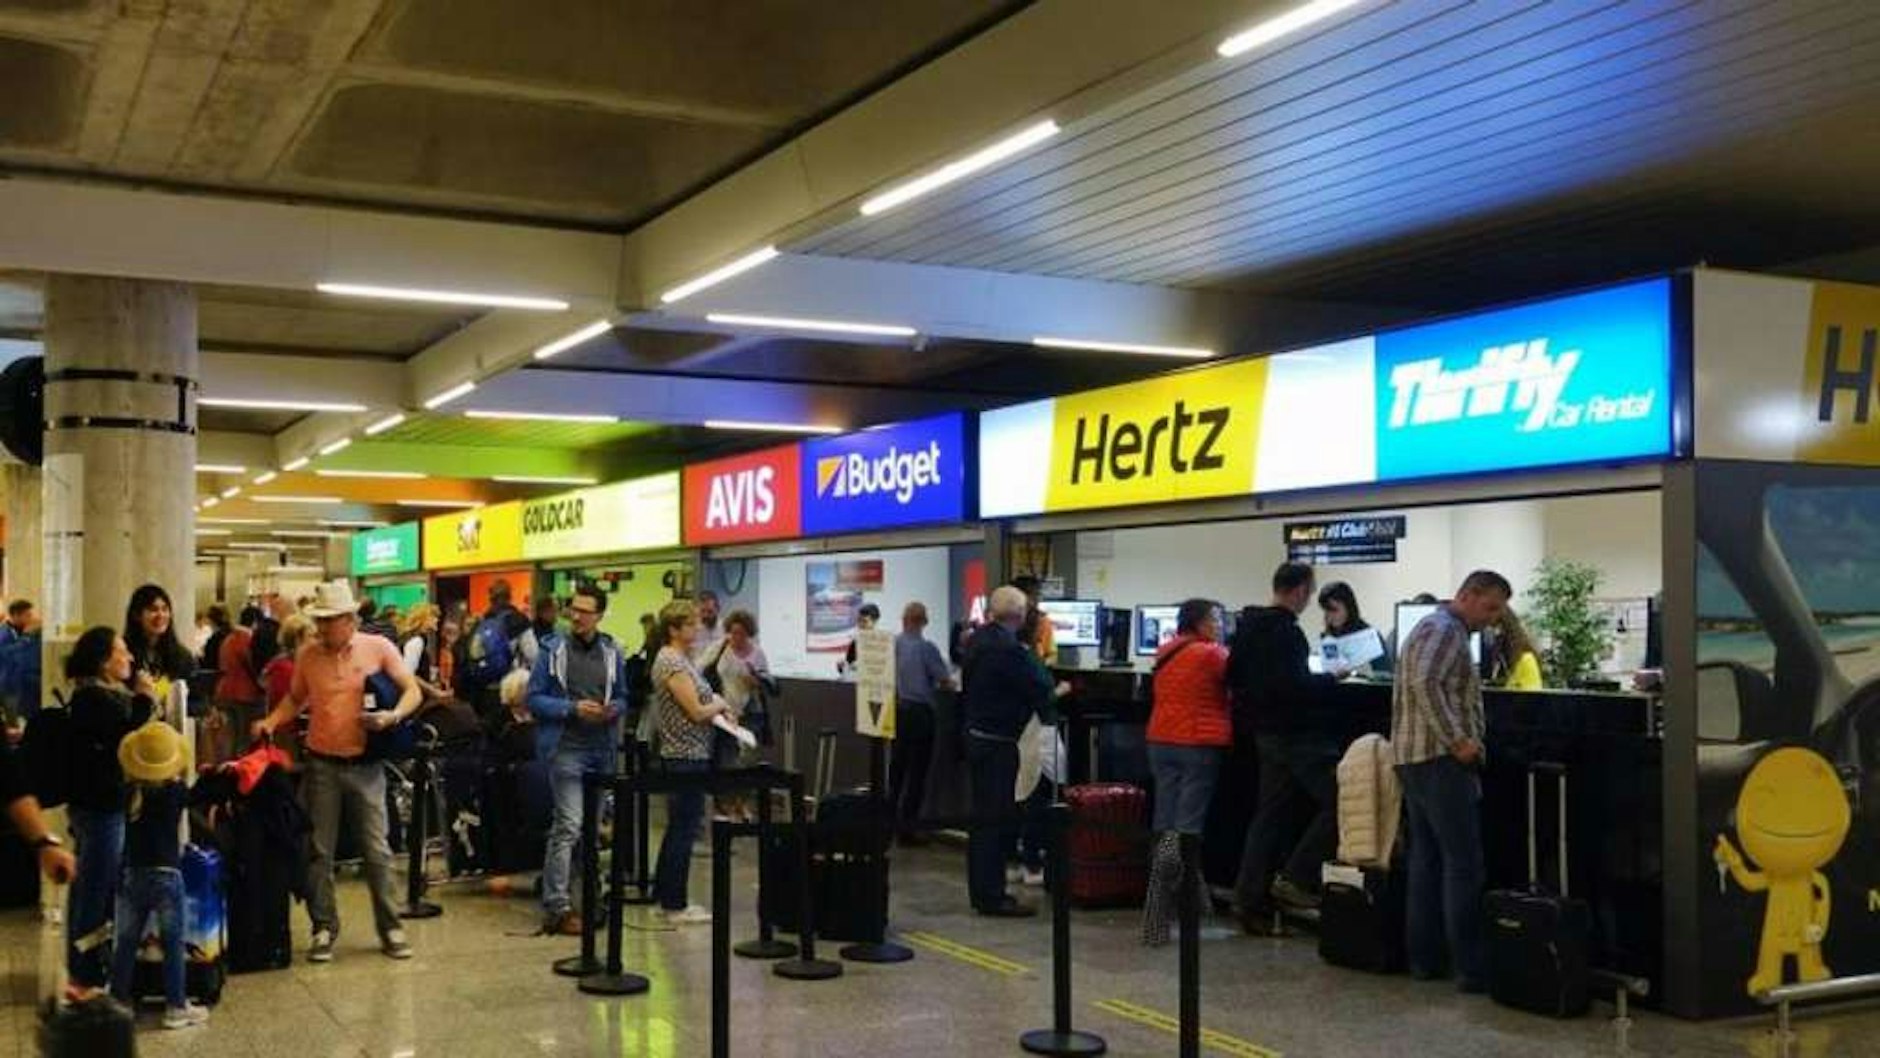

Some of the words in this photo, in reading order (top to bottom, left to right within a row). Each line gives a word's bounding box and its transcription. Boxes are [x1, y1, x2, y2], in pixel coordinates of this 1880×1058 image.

[1388, 337, 1583, 433] Thrifty
[1818, 325, 1880, 423] H
[1548, 402, 1584, 428] Car
[1585, 389, 1655, 423] Rental
[848, 440, 941, 503] Budget
[1071, 400, 1231, 485] Hertz
[523, 497, 585, 536] GOLDCAR
[705, 465, 775, 529] AVIS
